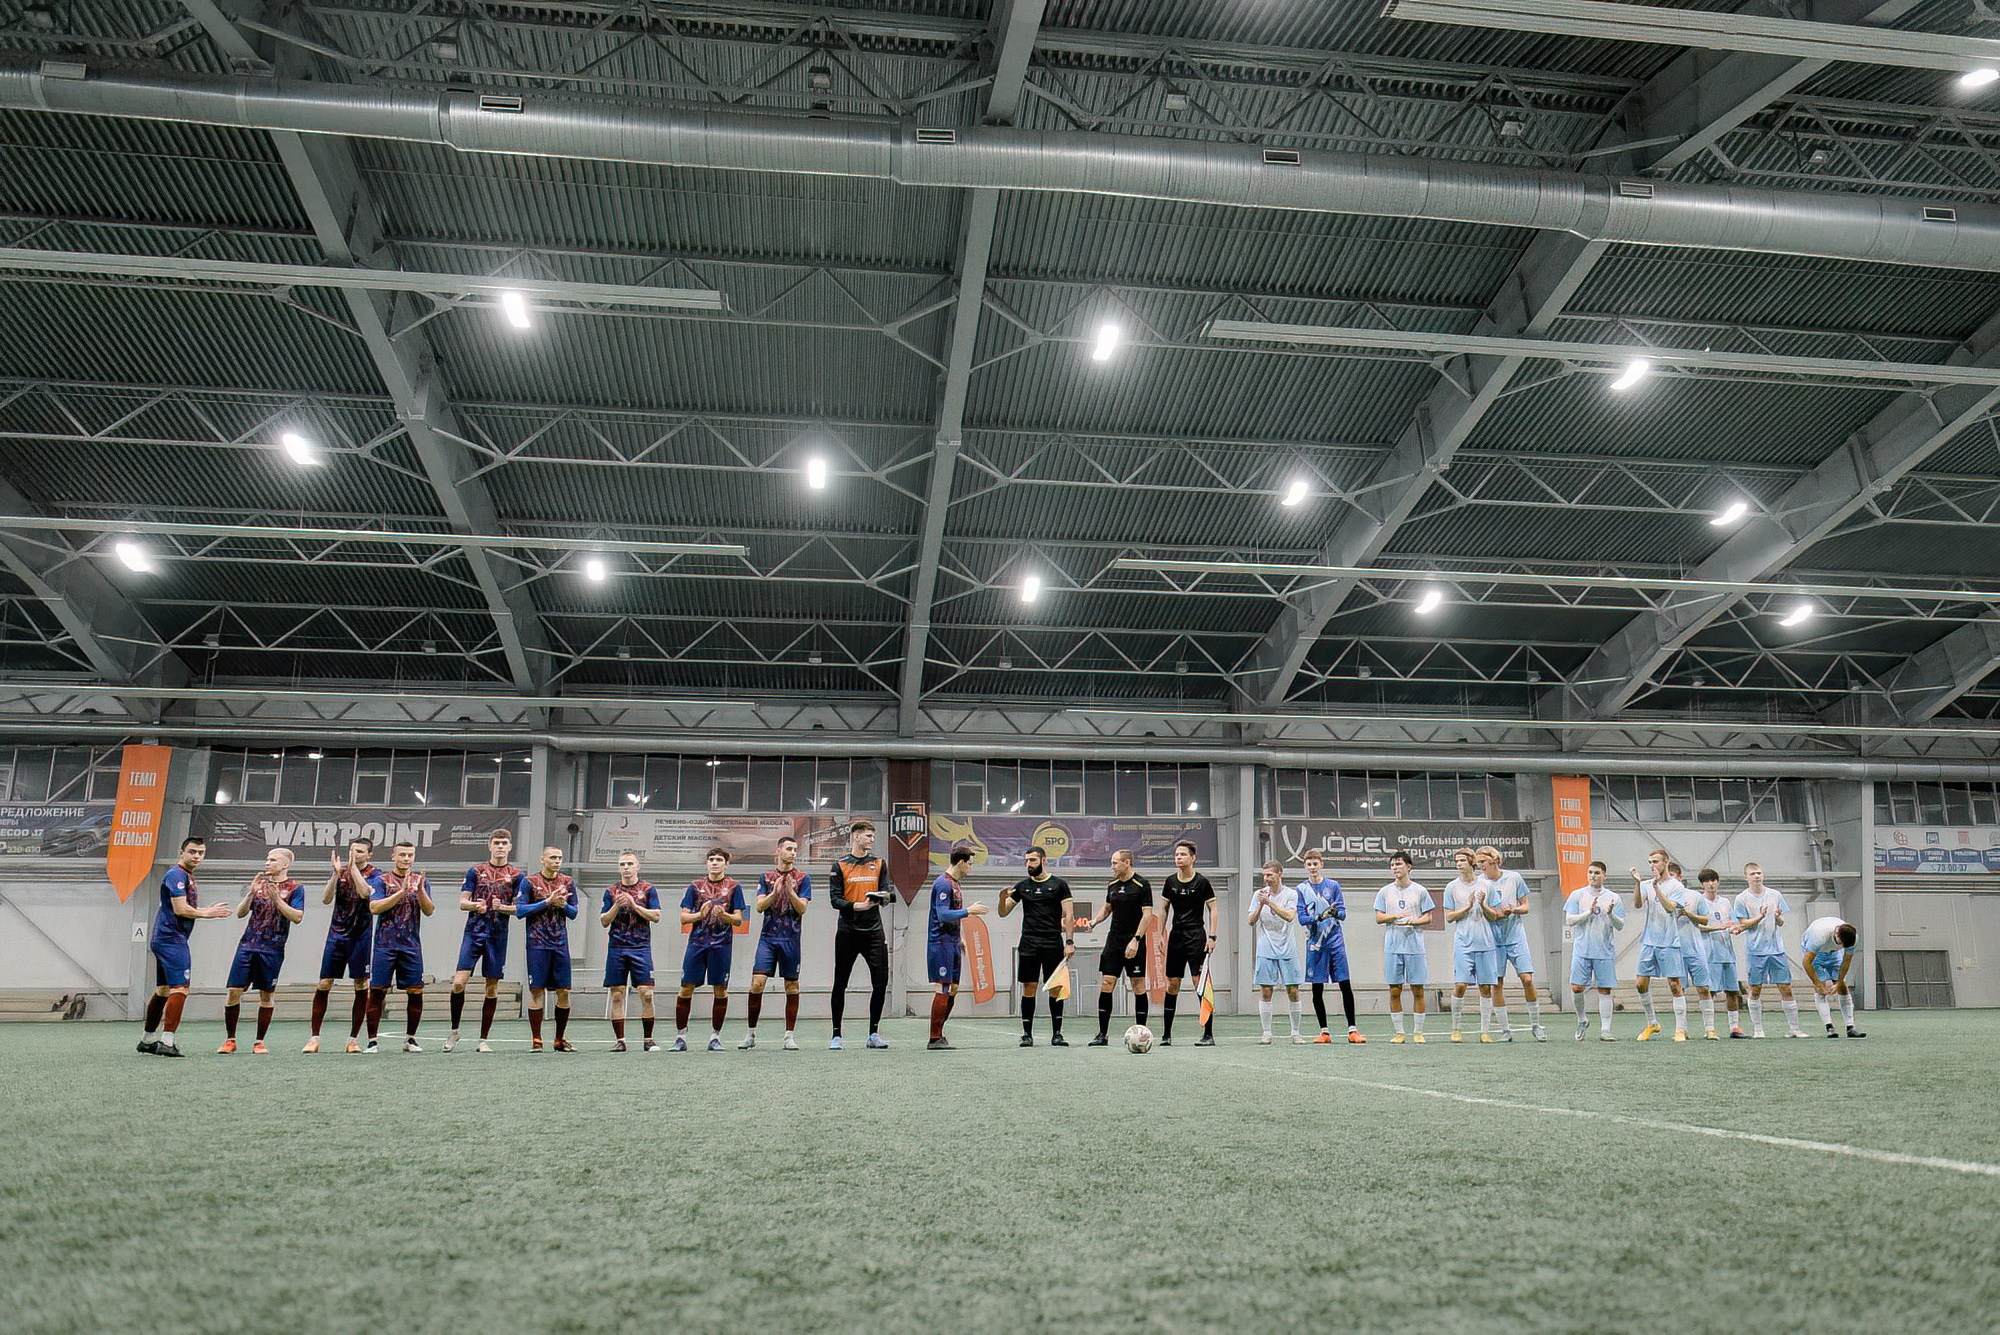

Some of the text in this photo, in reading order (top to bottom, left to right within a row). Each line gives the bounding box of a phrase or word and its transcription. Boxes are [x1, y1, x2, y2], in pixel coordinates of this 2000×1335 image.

[130, 772, 157, 786] ТЕМП
[121, 811, 151, 828] ОДНА
[894, 815, 924, 832] ТЕМП
[113, 831, 153, 847] СЕМЬЯ!
[1044, 837, 1066, 845] БРО
[1397, 835, 1530, 847] Футбольная экипировка
